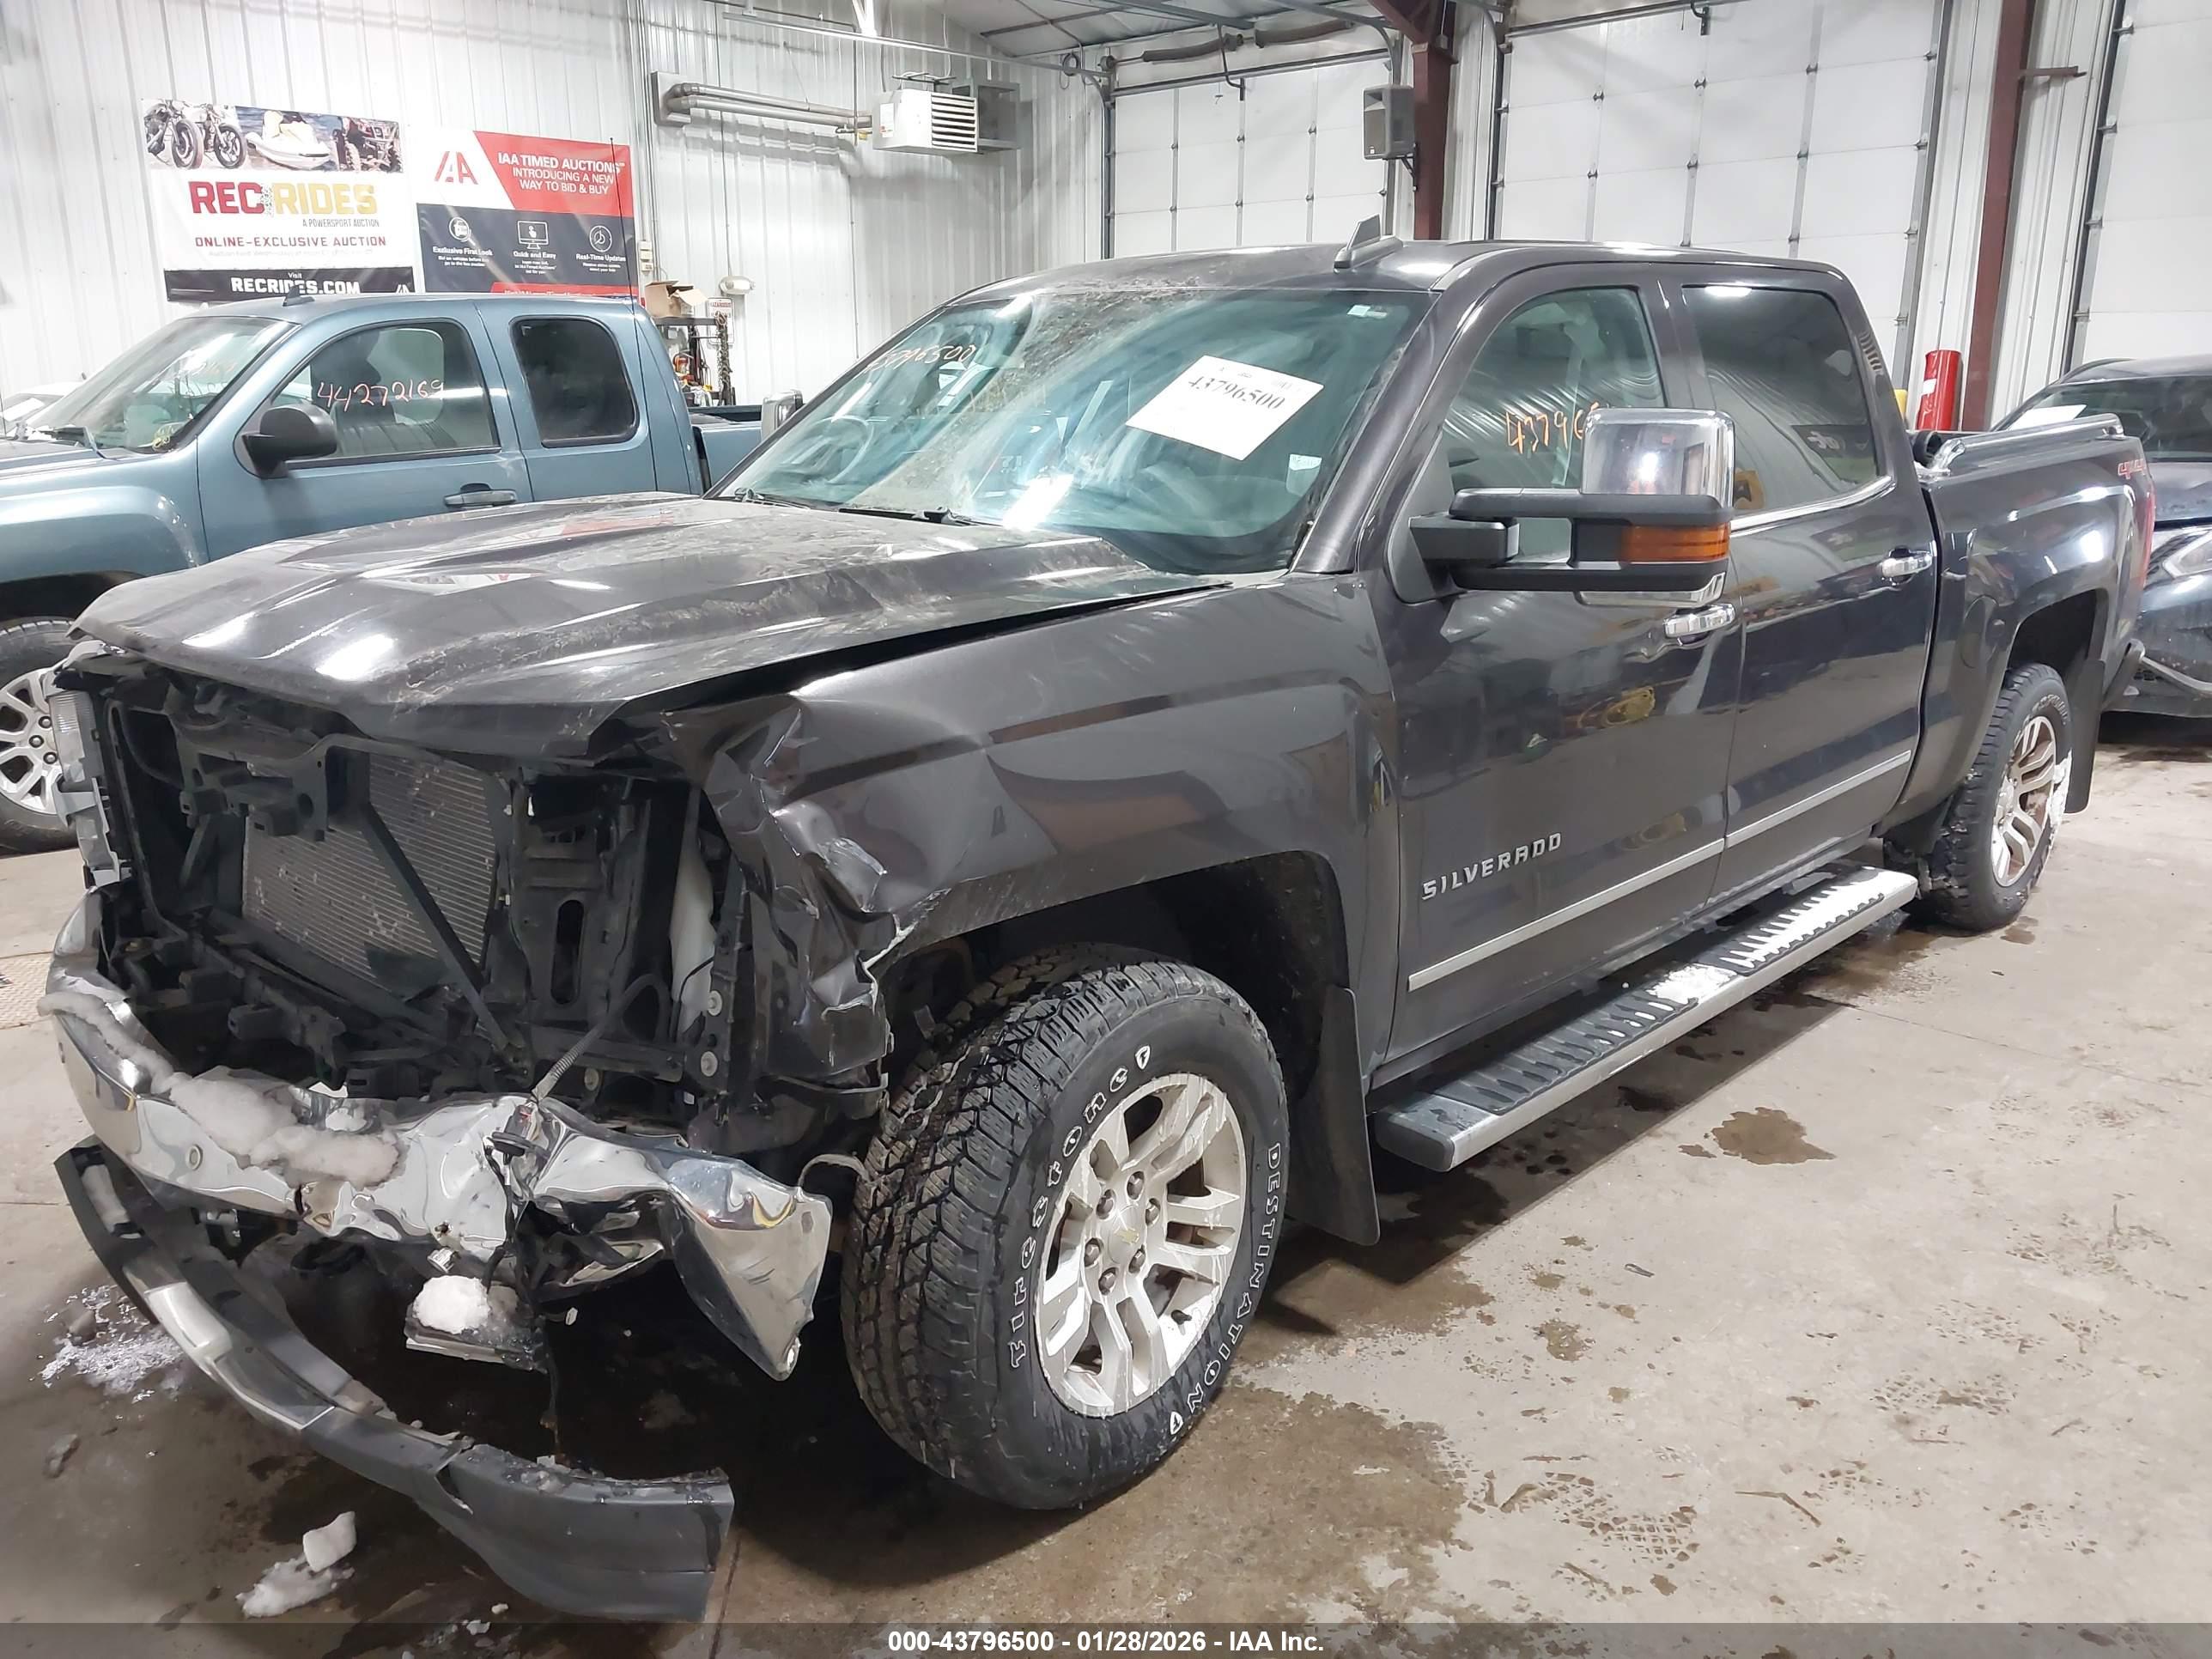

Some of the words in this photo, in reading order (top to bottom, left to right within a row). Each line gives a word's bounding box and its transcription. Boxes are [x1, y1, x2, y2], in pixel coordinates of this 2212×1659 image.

[498, 152, 520, 166] IAA
[520, 155, 559, 169] TIMED
[513, 167, 580, 182] INTRODUCING
[583, 173, 590, 182] A
[592, 174, 614, 185] NEW
[520, 179, 543, 190] WAY
[545, 181, 559, 191] TO
[562, 184, 577, 193] BID
[579, 184, 587, 194] &
[589, 185, 609, 195] BUY
[188, 181, 264, 215] REC
[273, 182, 378, 215] RIDES
[308, 219, 351, 228] POWERSPORT
[353, 219, 380, 228] AUCTION
[195, 236, 328, 247] ONLINE-EXCLUSIVE
[333, 236, 386, 246] AUCTION
[432, 246, 463, 255] Exclusive
[317, 379, 444, 412] 44272169
[1188, 376, 1285, 410] 43796500
[1421, 832, 1562, 901] SILVERADO
[1187, 1142, 1280, 1414] DESTINATION
